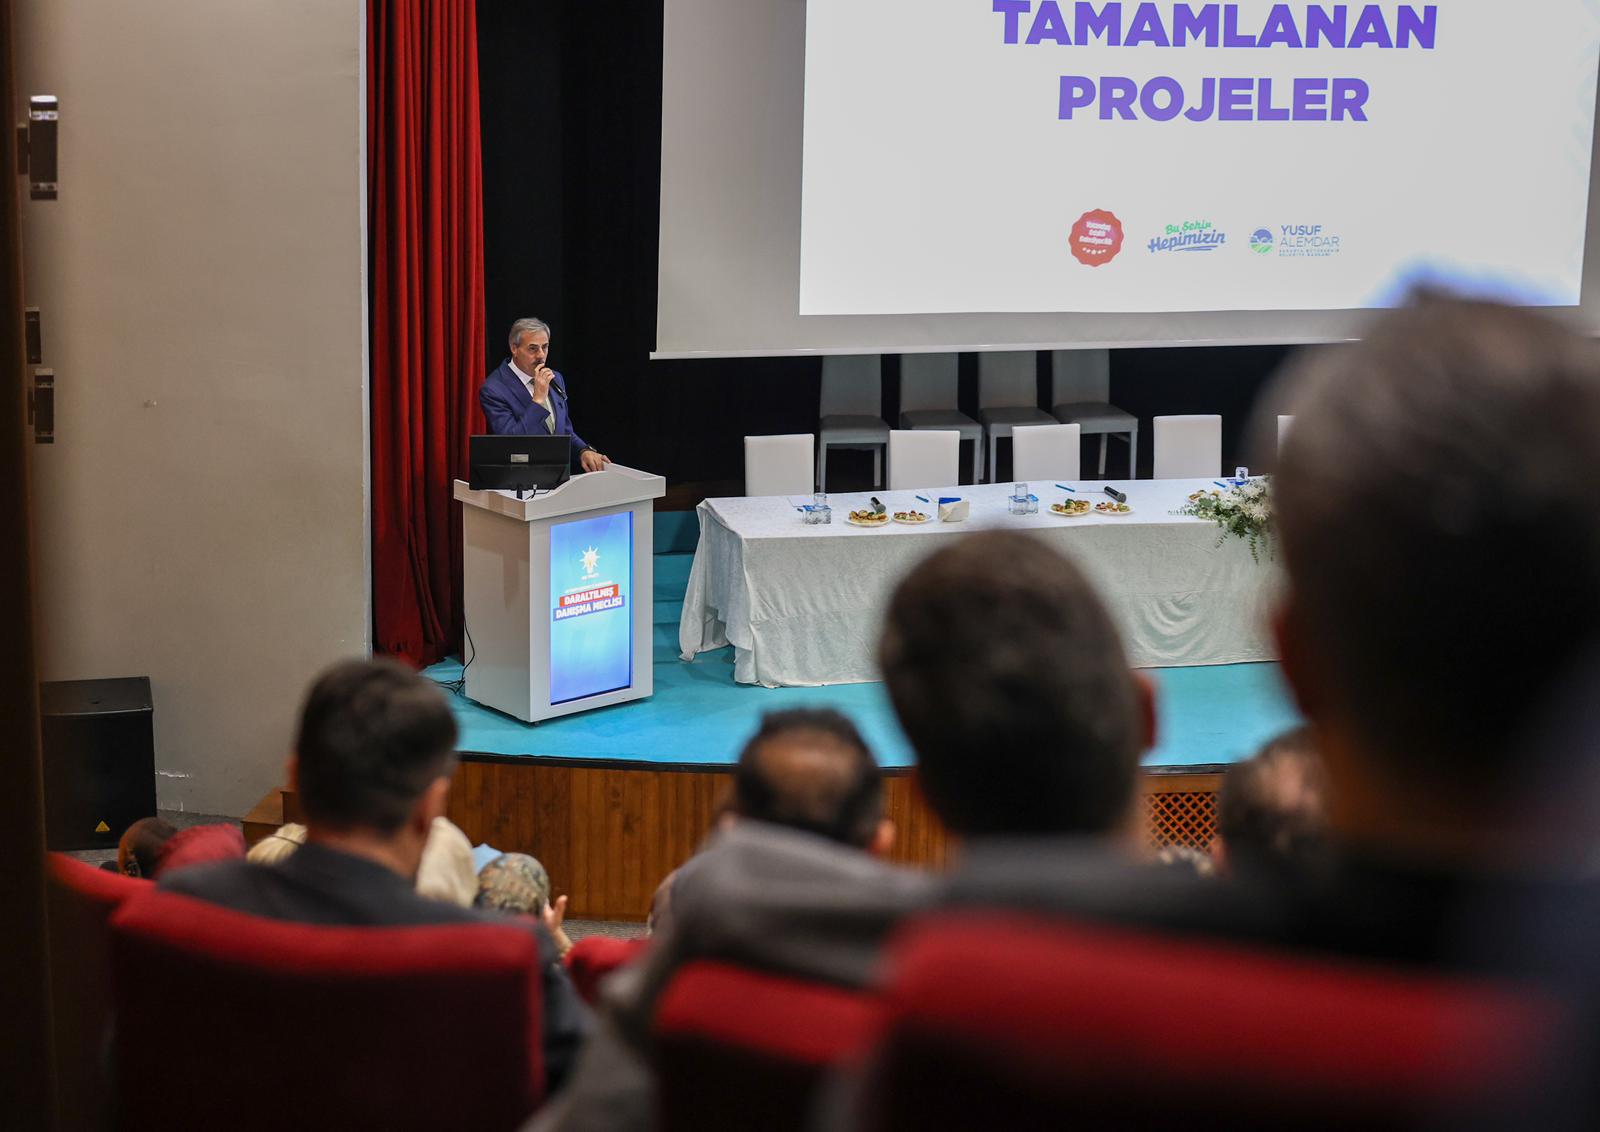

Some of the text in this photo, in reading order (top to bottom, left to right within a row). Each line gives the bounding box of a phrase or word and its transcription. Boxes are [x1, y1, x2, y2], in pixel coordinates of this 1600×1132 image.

[992, 0, 1437, 49] TAMAMLANAN
[1058, 76, 1369, 122] PROJELER
[1166, 224, 1180, 235] Bu
[1280, 225, 1322, 236] YUSUF
[1147, 229, 1226, 253] Hepimizin
[1280, 236, 1341, 248] ALEMDAR
